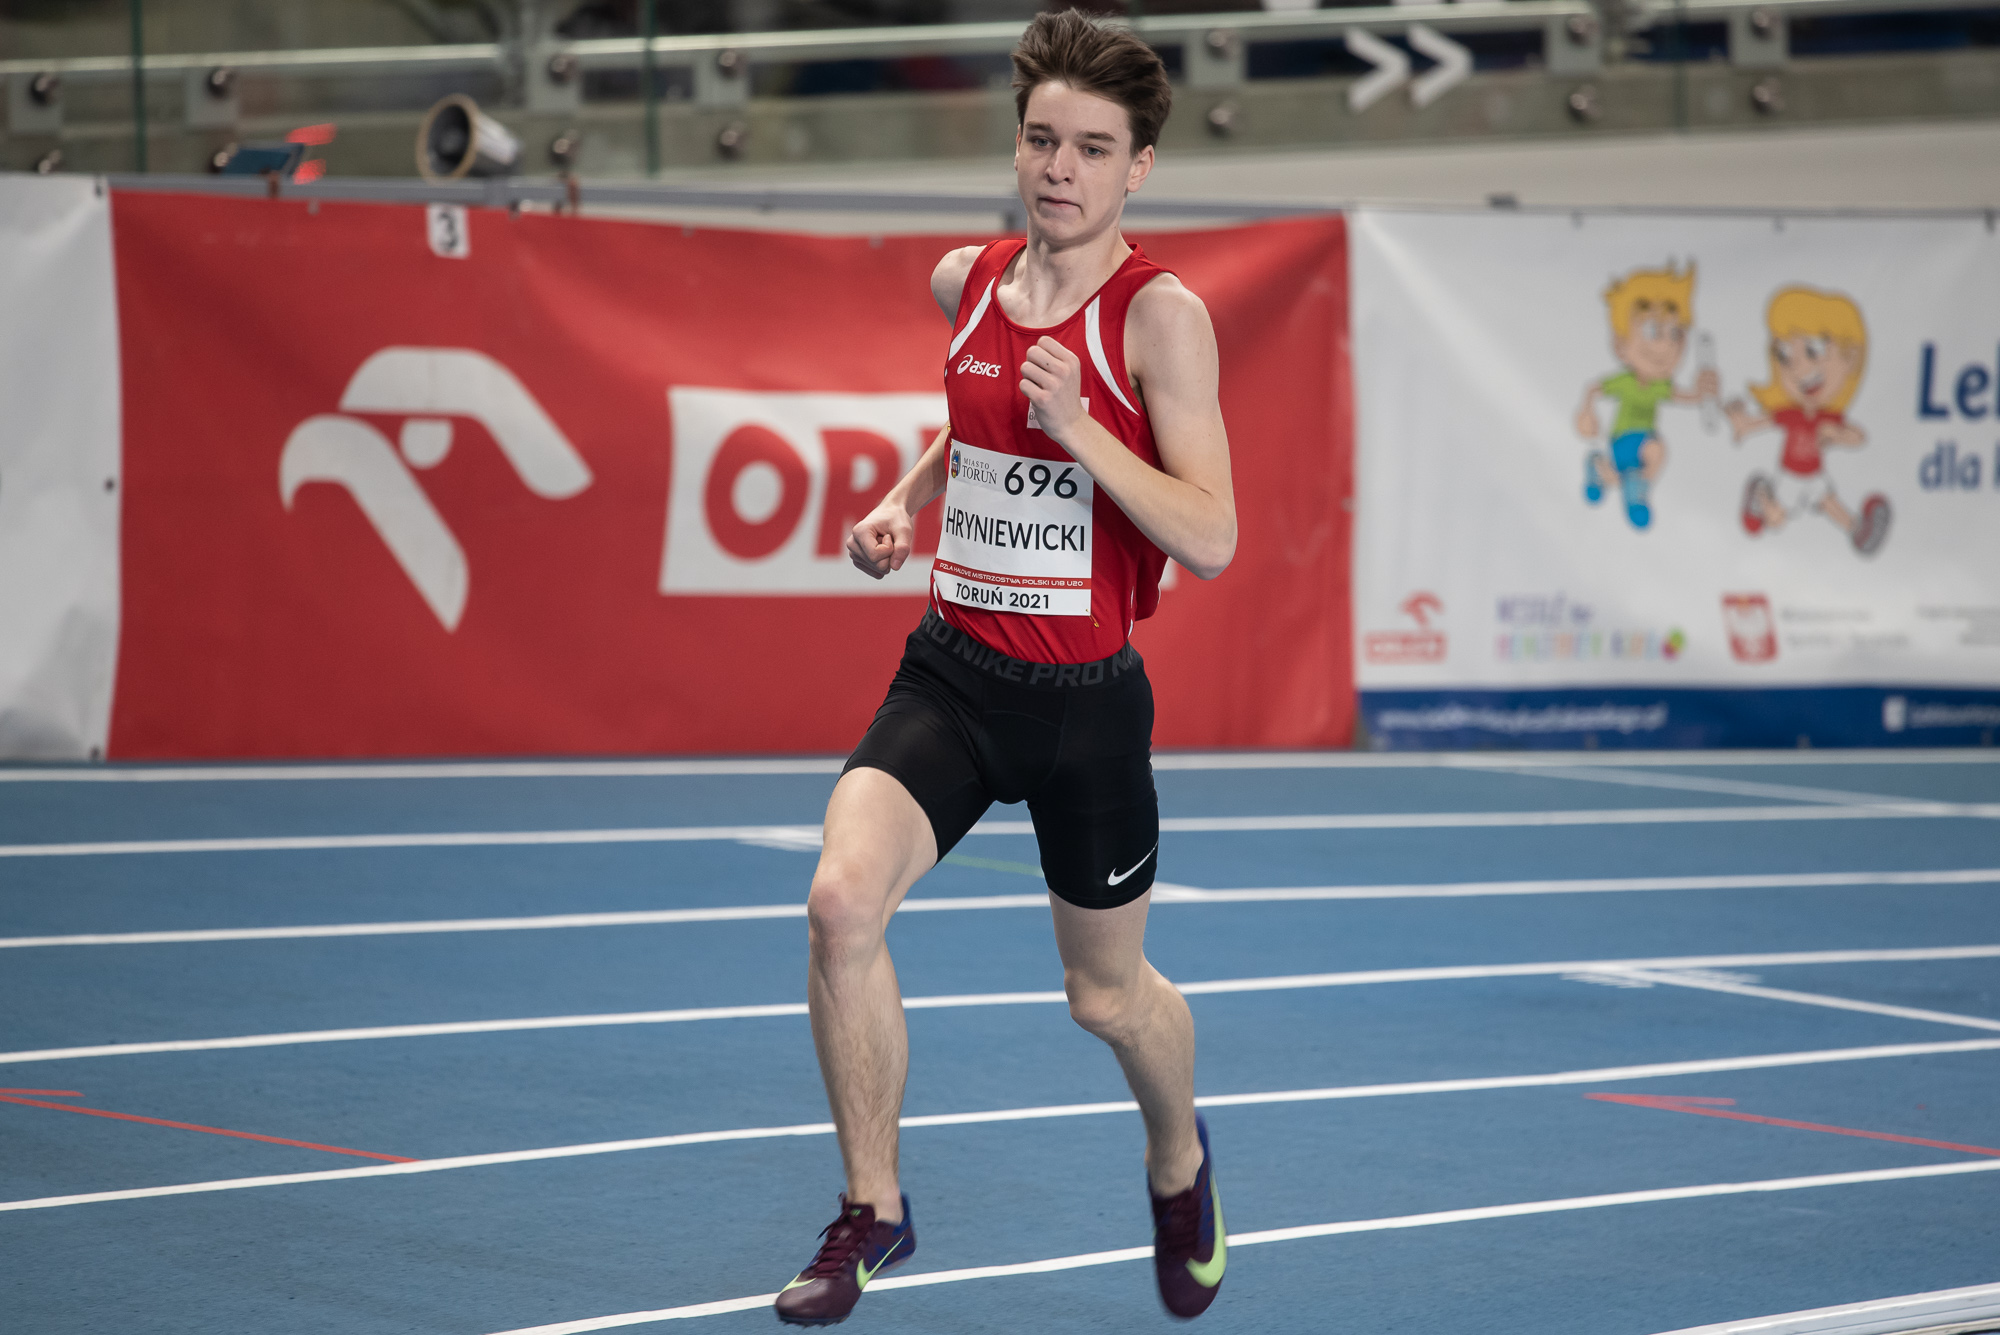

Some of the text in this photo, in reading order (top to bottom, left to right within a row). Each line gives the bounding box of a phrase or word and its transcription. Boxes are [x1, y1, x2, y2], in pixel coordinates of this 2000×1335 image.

[962, 465, 997, 485] TORUŃ
[963, 457, 990, 469] MIASTO
[1917, 439, 1982, 491] dla
[1004, 461, 1078, 499] 696
[946, 506, 1085, 551] HRYNIEWICKI
[939, 563, 954, 572] PZLA
[953, 566, 972, 577] HALOWE
[972, 573, 1021, 584] MISTRZOSTWA
[955, 582, 1049, 609] TORUŃ 2021
[953, 639, 1028, 681] NIKE
[1029, 663, 1103, 687] PRO
